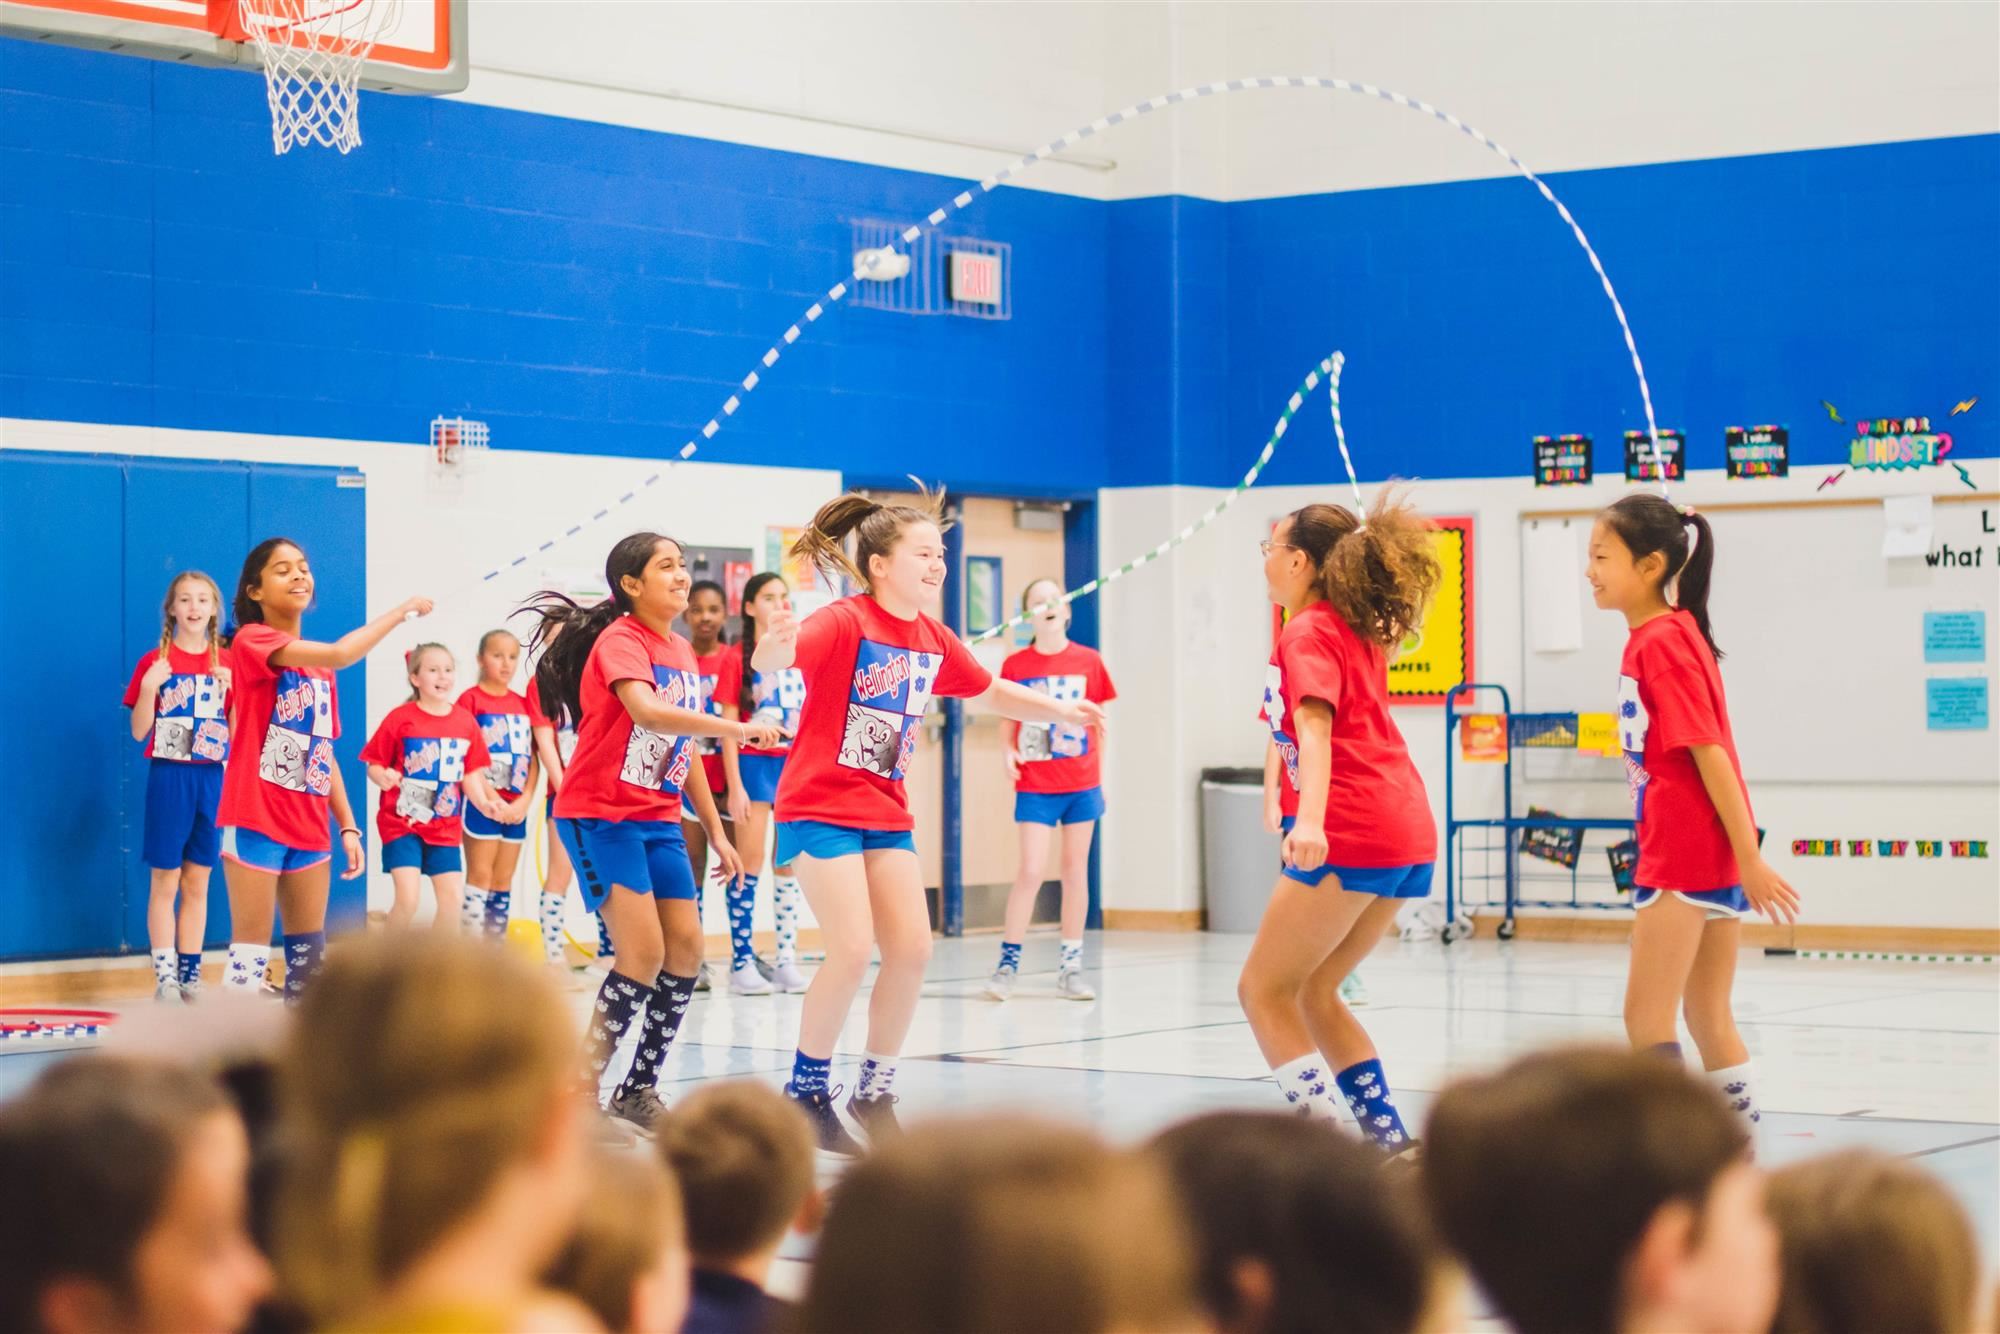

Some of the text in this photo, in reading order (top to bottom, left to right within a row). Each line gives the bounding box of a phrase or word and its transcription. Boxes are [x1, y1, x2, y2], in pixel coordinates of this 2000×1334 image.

[961, 259, 993, 297] EXIT
[1850, 432, 1953, 465] MINDSET?
[1925, 544, 1983, 568] what
[854, 653, 910, 702] Wellington
[276, 681, 314, 723] Wellgtn
[1791, 838, 1988, 858] CHANGE THE WAY YOU THINK
